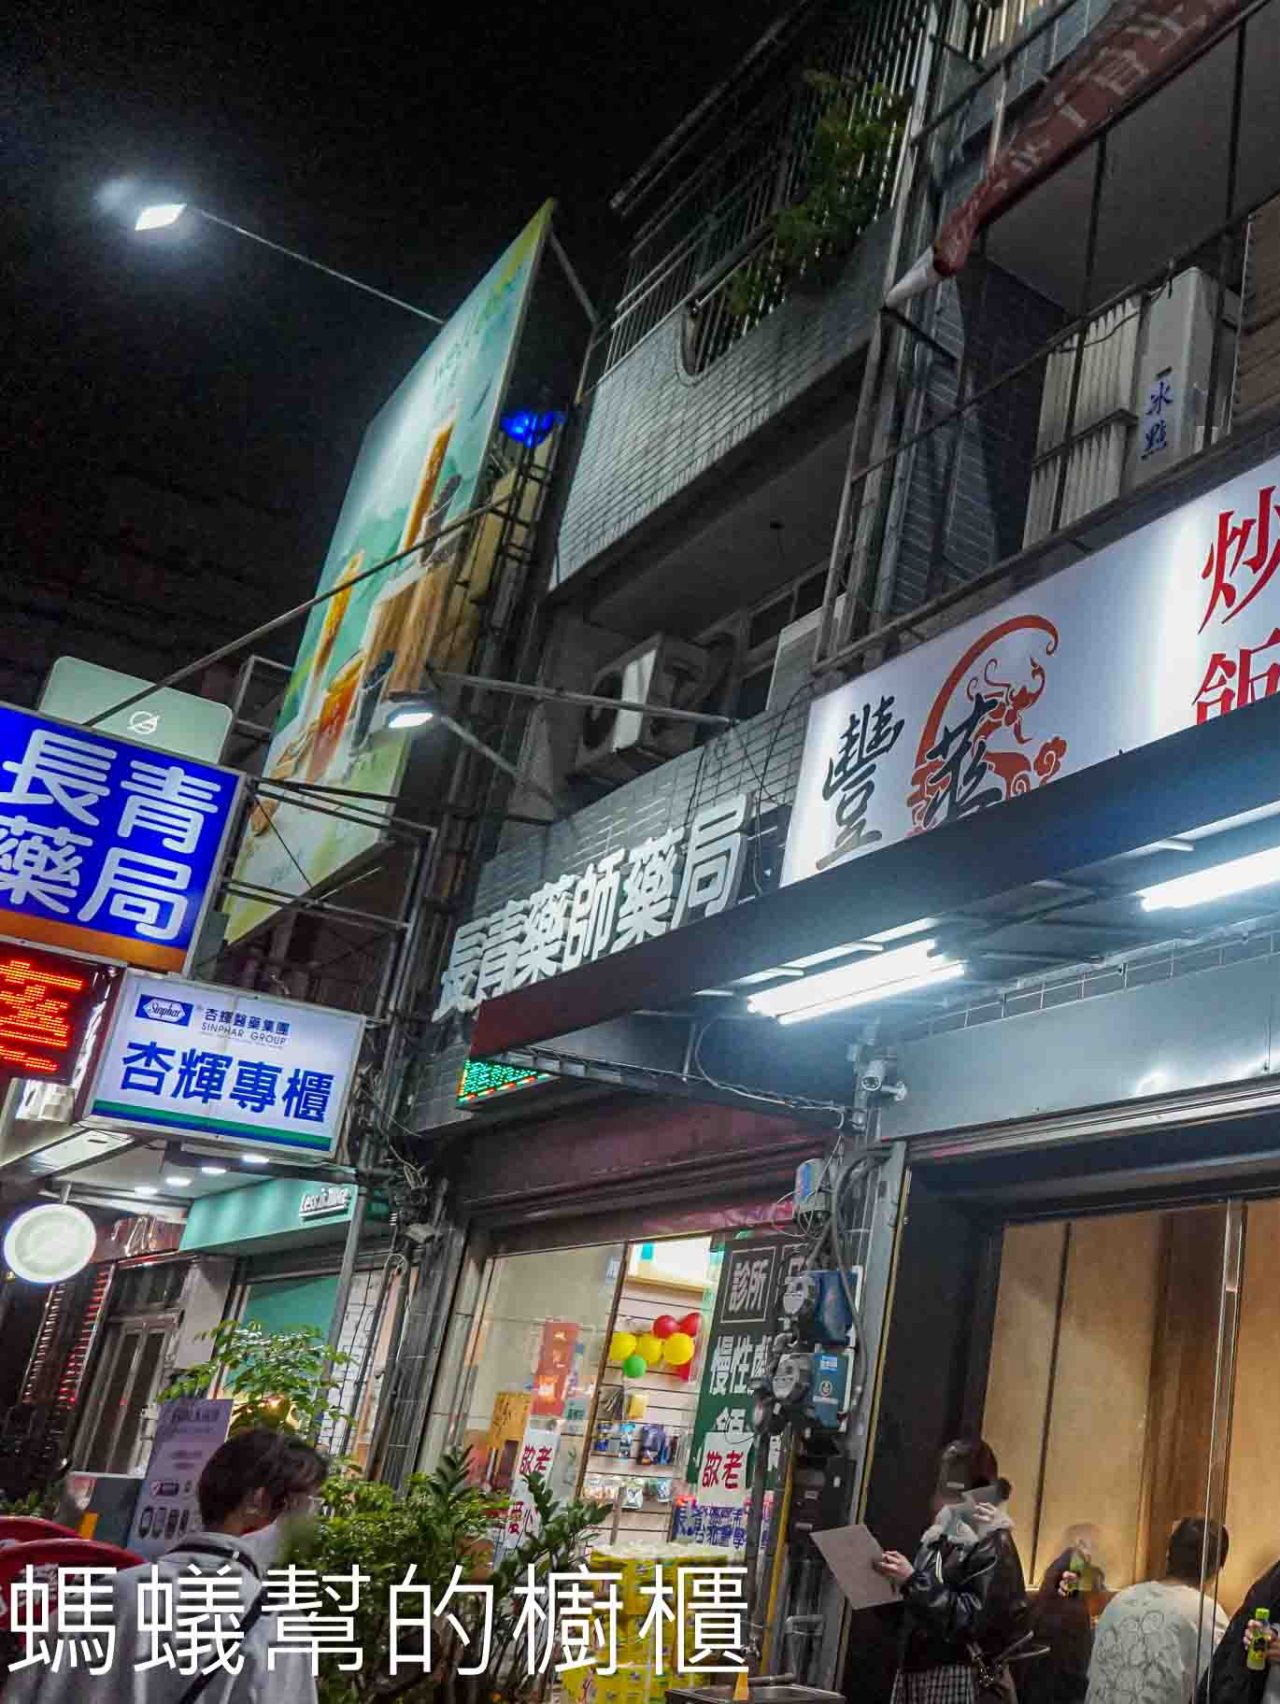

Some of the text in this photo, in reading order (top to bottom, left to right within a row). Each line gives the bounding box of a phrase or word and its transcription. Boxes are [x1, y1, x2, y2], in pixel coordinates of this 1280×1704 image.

[0, 729, 221, 854] 長青
[0, 815, 192, 940] 藥局
[431, 793, 749, 1023] 長青藥師藥局
[120, 1041, 334, 1123] 杏輝專櫃
[202, 1022, 244, 1038] SINPHAR
[250, 1031, 287, 1045] GROUP
[702, 1450, 744, 1489] 敬老
